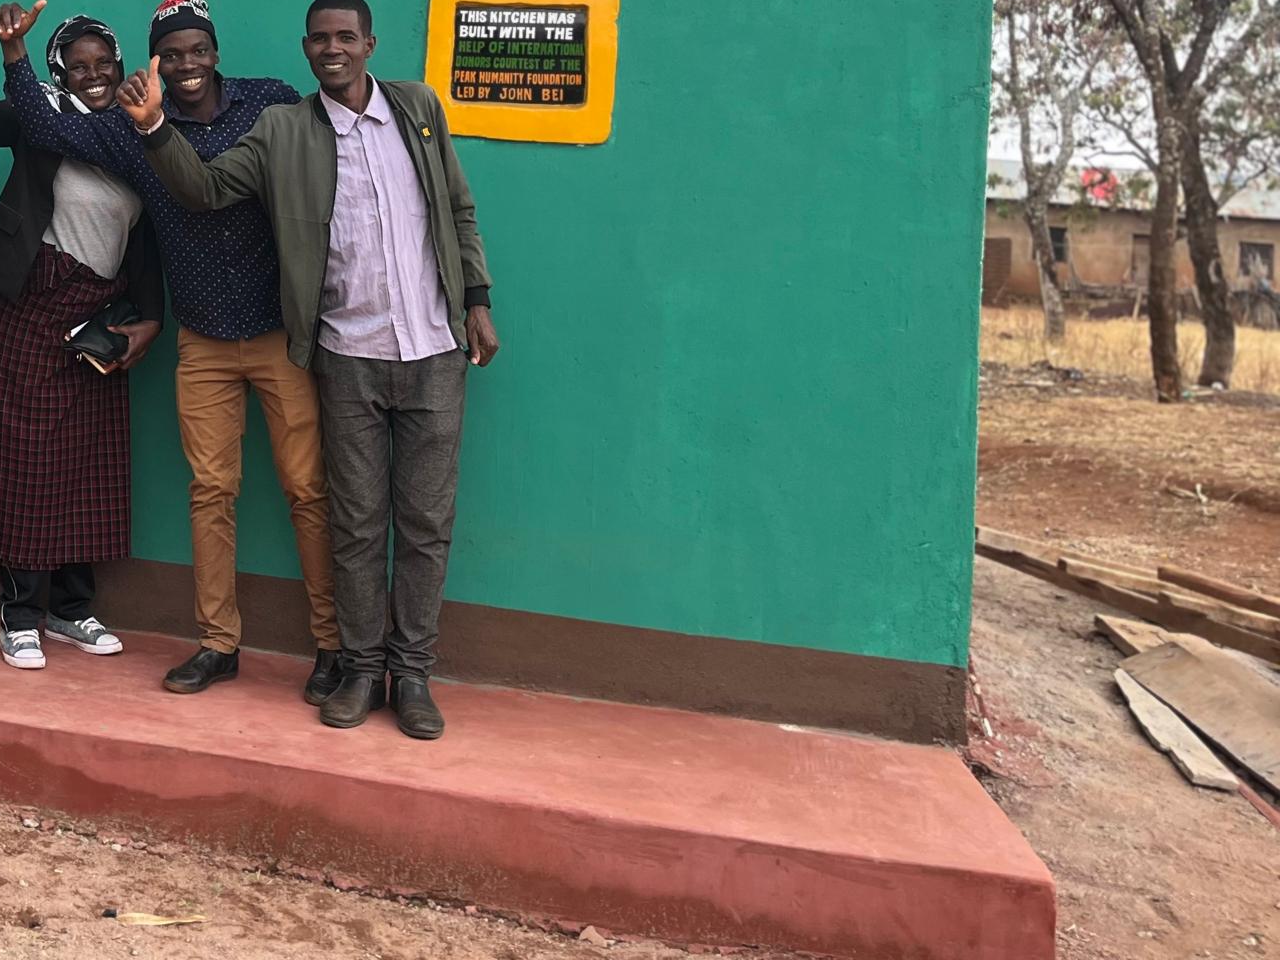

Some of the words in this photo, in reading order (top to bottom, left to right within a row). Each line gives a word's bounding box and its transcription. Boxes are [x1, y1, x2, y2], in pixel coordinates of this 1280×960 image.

[460, 10, 487, 23] THIS
[490, 11, 545, 23] KITCHEN
[548, 12, 576, 24] WAS
[459, 26, 497, 38] BUILT
[499, 27, 535, 39] WITH
[545, 27, 574, 39] THE
[459, 41, 484, 53] HELP
[489, 41, 505, 53] OF
[456, 56, 491, 67] DONORS
[543, 59, 555, 70] OF
[560, 59, 580, 70] THE
[454, 71, 476, 83] PEAK
[479, 72, 524, 84] HUMANITY
[527, 73, 582, 85] FOUNDATION
[457, 87, 474, 98] LED
[478, 87, 490, 98] BY
[499, 88, 532, 101] JOHN
[542, 89, 564, 101] BEI
